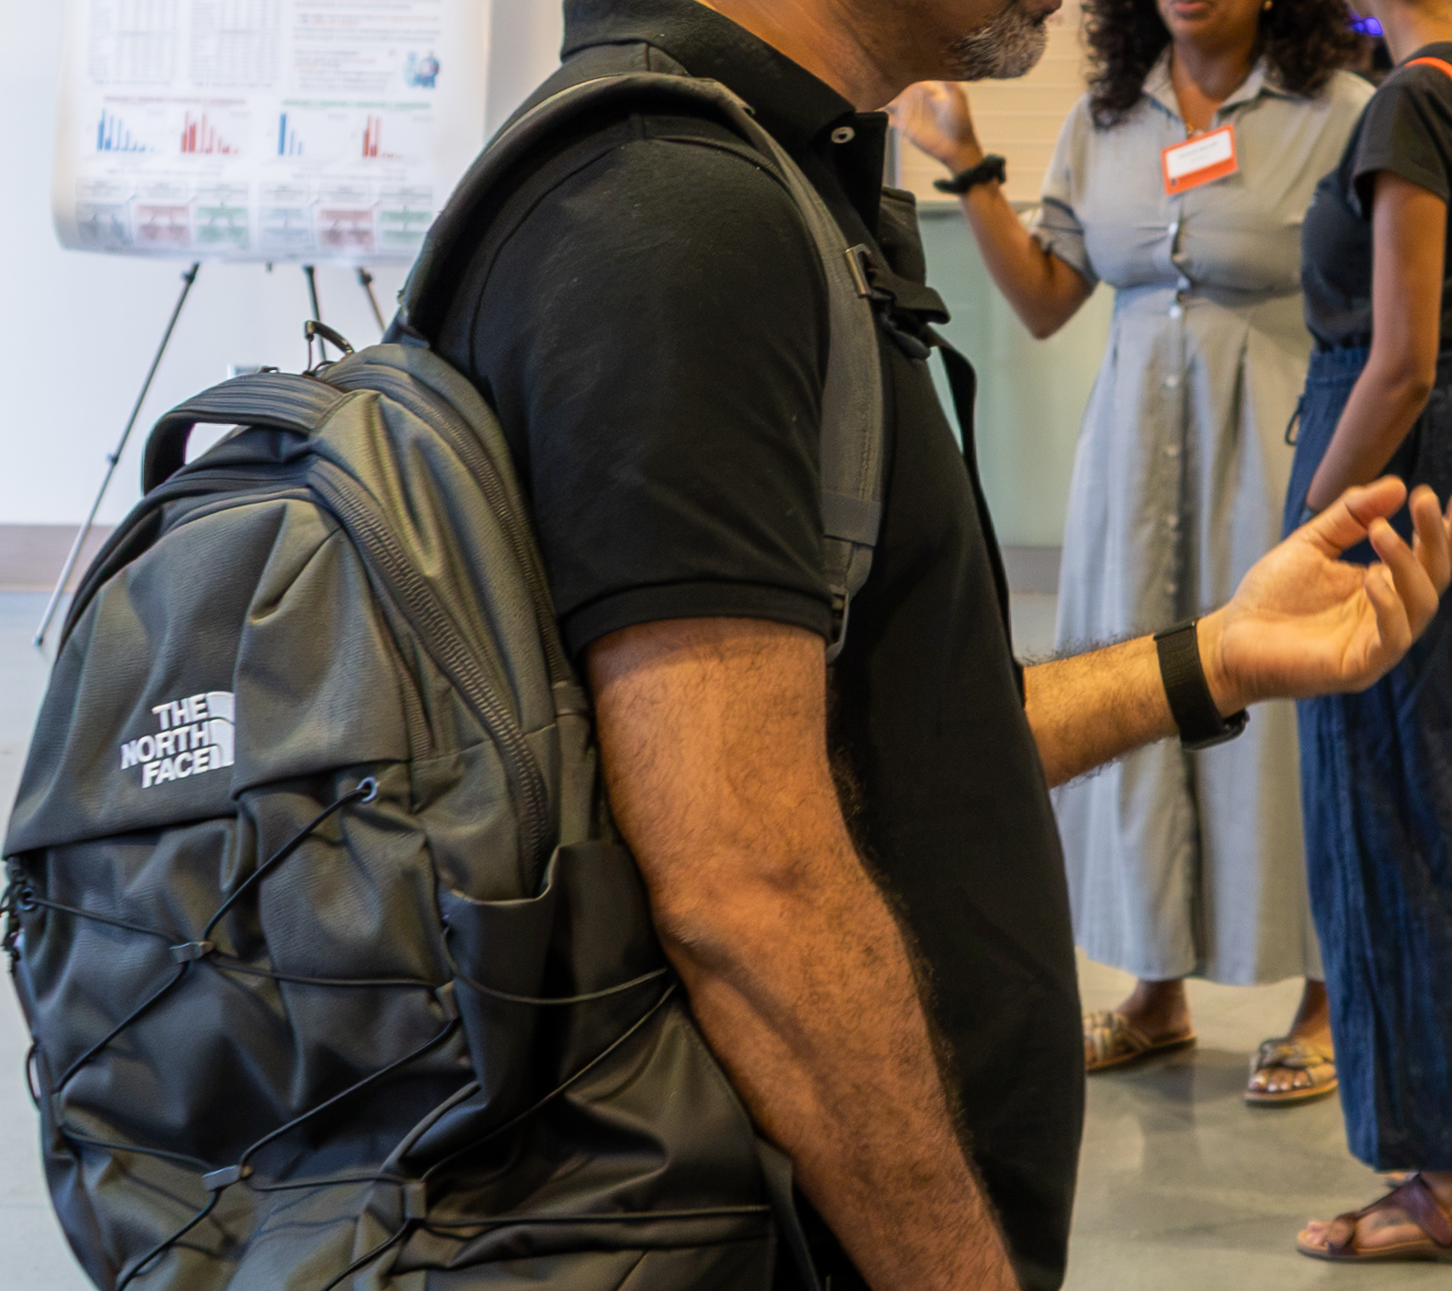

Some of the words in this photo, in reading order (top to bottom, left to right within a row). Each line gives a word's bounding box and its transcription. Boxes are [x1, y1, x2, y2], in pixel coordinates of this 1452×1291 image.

[151, 692, 207, 730] THE
[121, 720, 208, 770] NORTH
[142, 745, 212, 788] FACE
